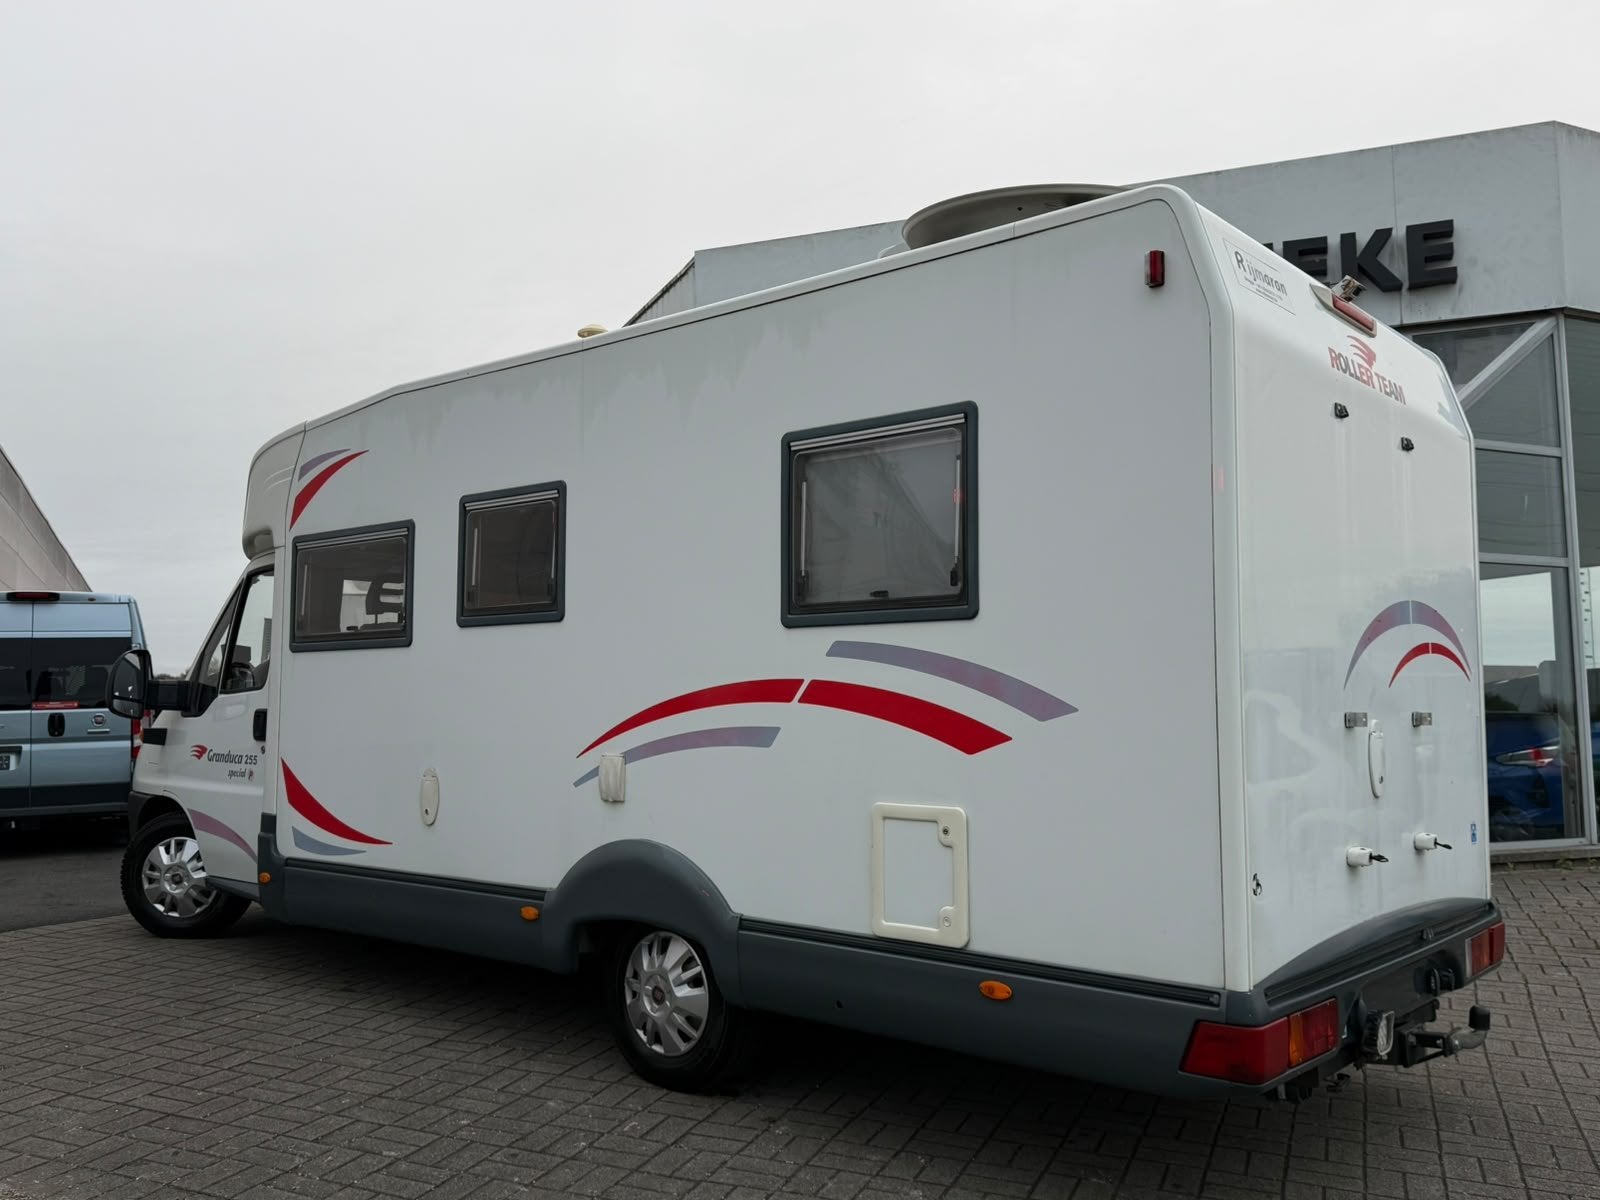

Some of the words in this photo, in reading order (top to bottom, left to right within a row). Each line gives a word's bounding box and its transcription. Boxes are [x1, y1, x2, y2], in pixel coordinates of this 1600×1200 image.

[1263, 219, 1458, 292] EKE
[1328, 346, 1376, 389] ROLLER
[1374, 372, 1406, 405] TEAM
[207, 748, 243, 765] Granduca
[244, 754, 258, 765] 255
[227, 768, 247, 780] special
